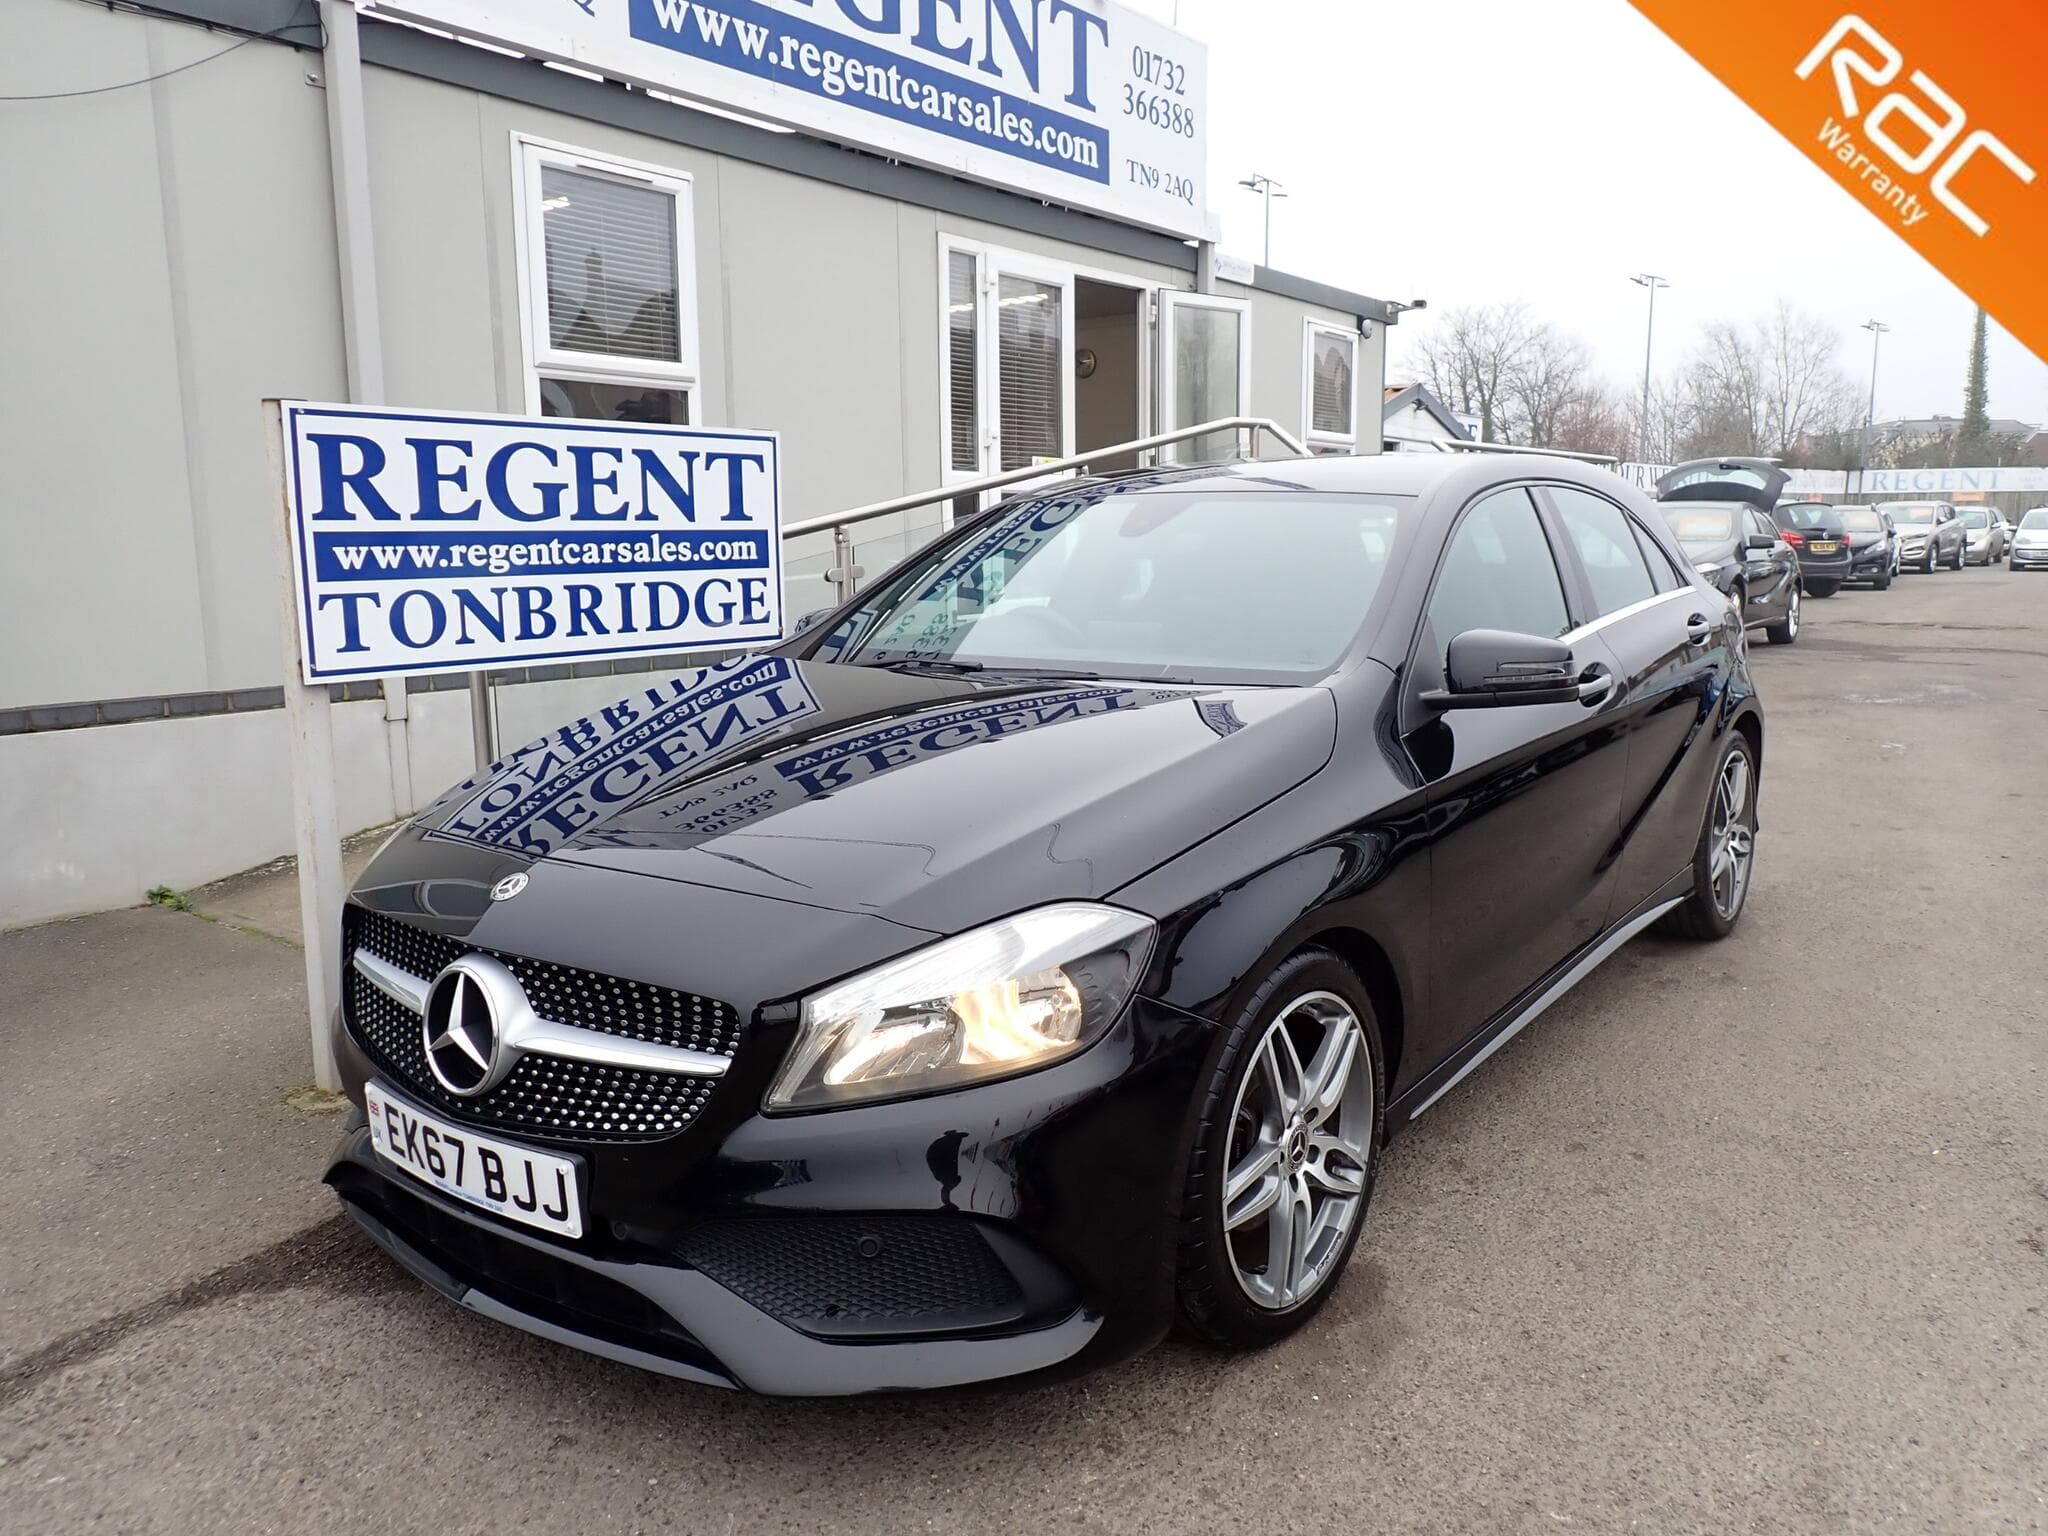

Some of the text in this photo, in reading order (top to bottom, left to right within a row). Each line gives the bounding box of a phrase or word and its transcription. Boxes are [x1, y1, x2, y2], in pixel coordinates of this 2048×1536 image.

[653, 0, 1099, 168] www.regentcarsales.com
[1132, 45, 1185, 96] 01732
[1122, 83, 1194, 138] 366388
[1126, 158, 1194, 206] TN9 2AQ
[306, 432, 764, 523] REGENT
[1871, 471, 2003, 491] REGENT
[332, 533, 758, 574] www.regentcarsales.com
[318, 577, 771, 654] TONBRIDGE
[384, 1102, 465, 1187] EK67
[477, 1146, 569, 1222] BJJ
